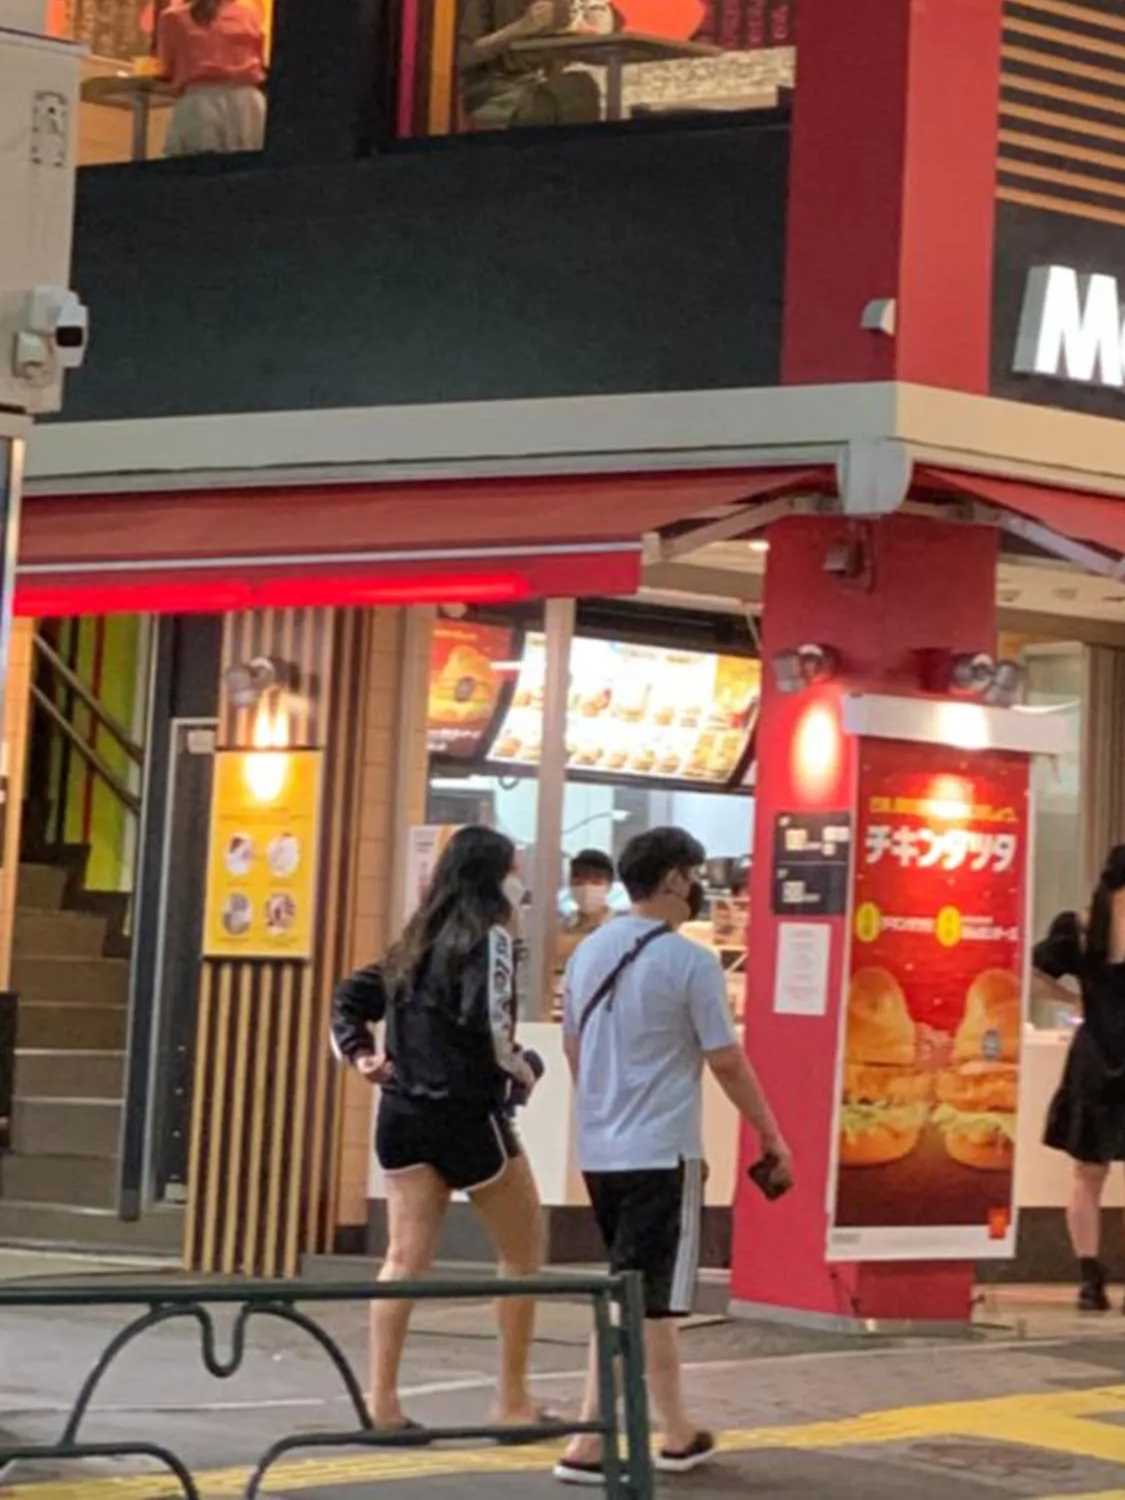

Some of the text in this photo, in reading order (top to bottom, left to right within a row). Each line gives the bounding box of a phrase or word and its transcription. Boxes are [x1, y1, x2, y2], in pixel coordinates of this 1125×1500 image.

[864, 824, 1017, 873] チキンタツタ
